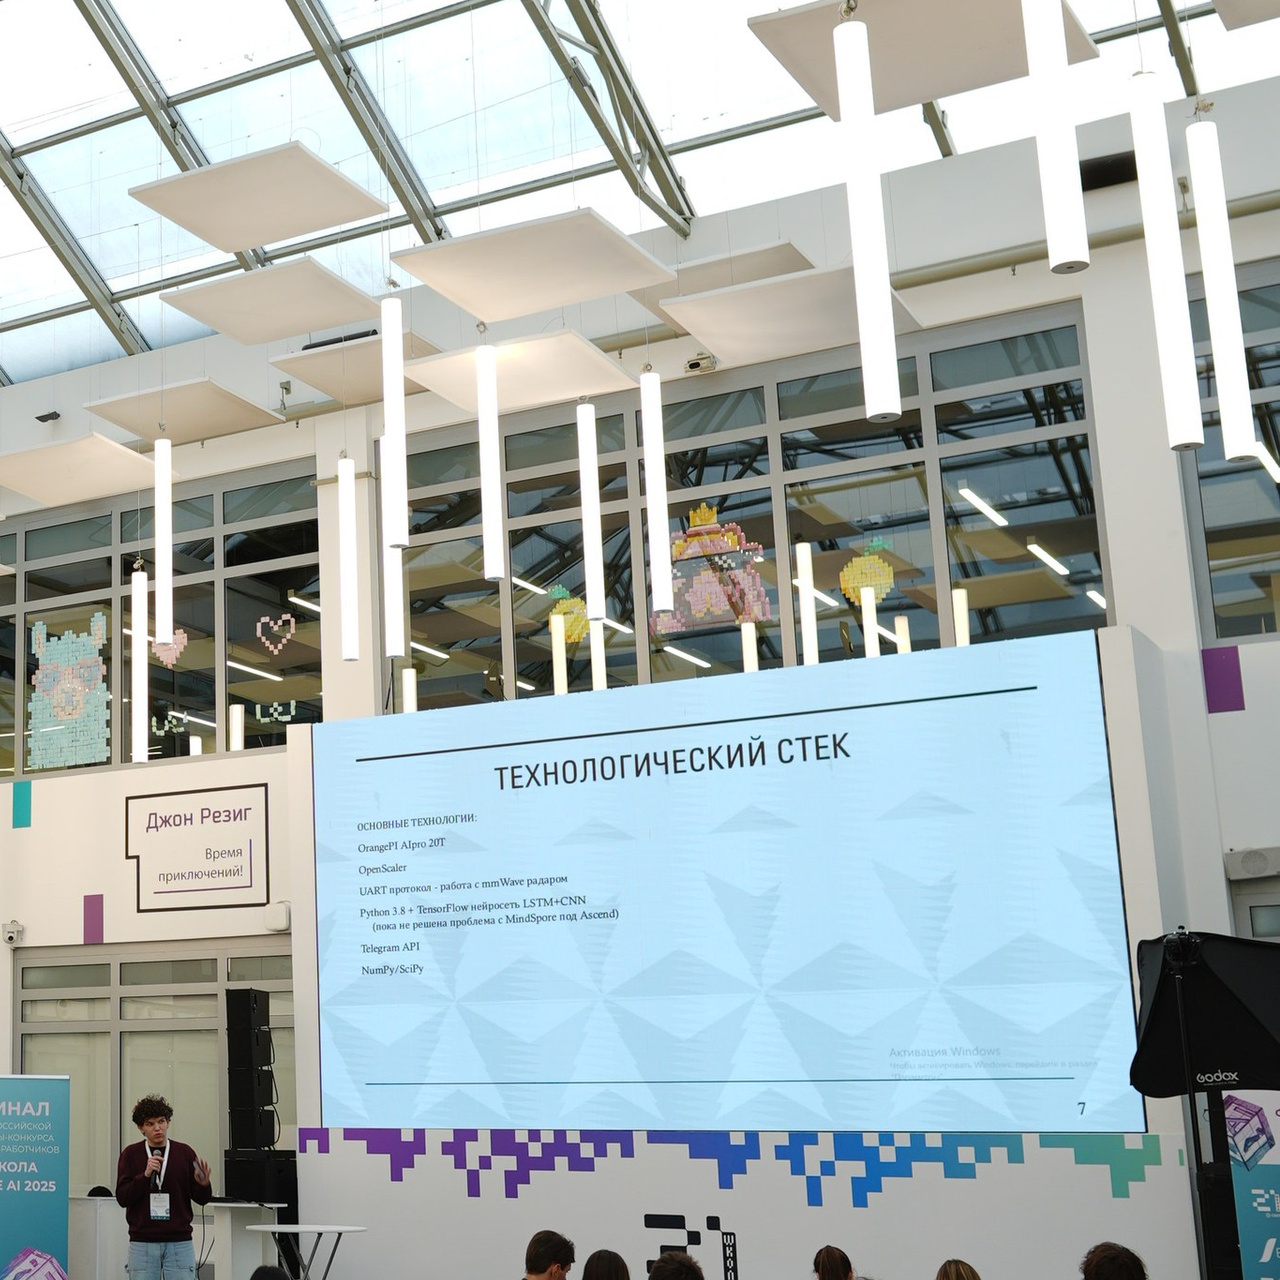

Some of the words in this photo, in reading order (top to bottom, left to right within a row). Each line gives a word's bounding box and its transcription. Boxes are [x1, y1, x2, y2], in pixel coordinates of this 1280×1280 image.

[494, 734, 766, 791] ТЕХНОЛОГИЧЕСКИЙ
[777, 732, 852, 765] СТЕК
[145, 812, 194, 833] Джон
[200, 807, 252, 825] Резиг
[357, 819, 409, 831] ОСНОВНЫЕ
[411, 813, 477, 828] ТЕХНОЛОГИИ:
[358, 841, 398, 853] OrangePI
[401, 839, 427, 851] AIpro
[428, 837, 446, 848] 20T
[205, 847, 243, 862] Время
[158, 865, 243, 885] приключений!
[358, 863, 407, 876] OpenScaler
[359, 885, 388, 897] UART
[389, 883, 432, 896] протокол
[440, 880, 472, 893] работа
[474, 881, 480, 889] с
[481, 876, 525, 889] mmWave
[526, 874, 568, 888] радаром
[360, 907, 390, 920] Python
[392, 906, 406, 916] 3.8
[417, 903, 469, 915] TensorFlow
[470, 899, 520, 913] нейросеть
[523, 895, 587, 909] LSTM+CNN
[372, 921, 397, 933] (пока
[399, 922, 410, 930] не
[412, 920, 448, 931] решена
[449, 916, 496, 929] проблема
[505, 912, 557, 926] MindSpore
[559, 912, 578, 923] под
[580, 908, 620, 921] Ascend)
[361, 943, 400, 955] Telegram
[402, 942, 420, 952] API
[361, 964, 424, 976] NumPy/SciPy
[889, 1047, 948, 1058] Активация
[950, 1046, 1001, 1057] Windows
[1196, 1068, 1240, 1084] Godox
[1077, 1101, 1086, 1116] 7
[6, 1180, 21, 1191] AI
[24, 1180, 57, 1192] 2025
